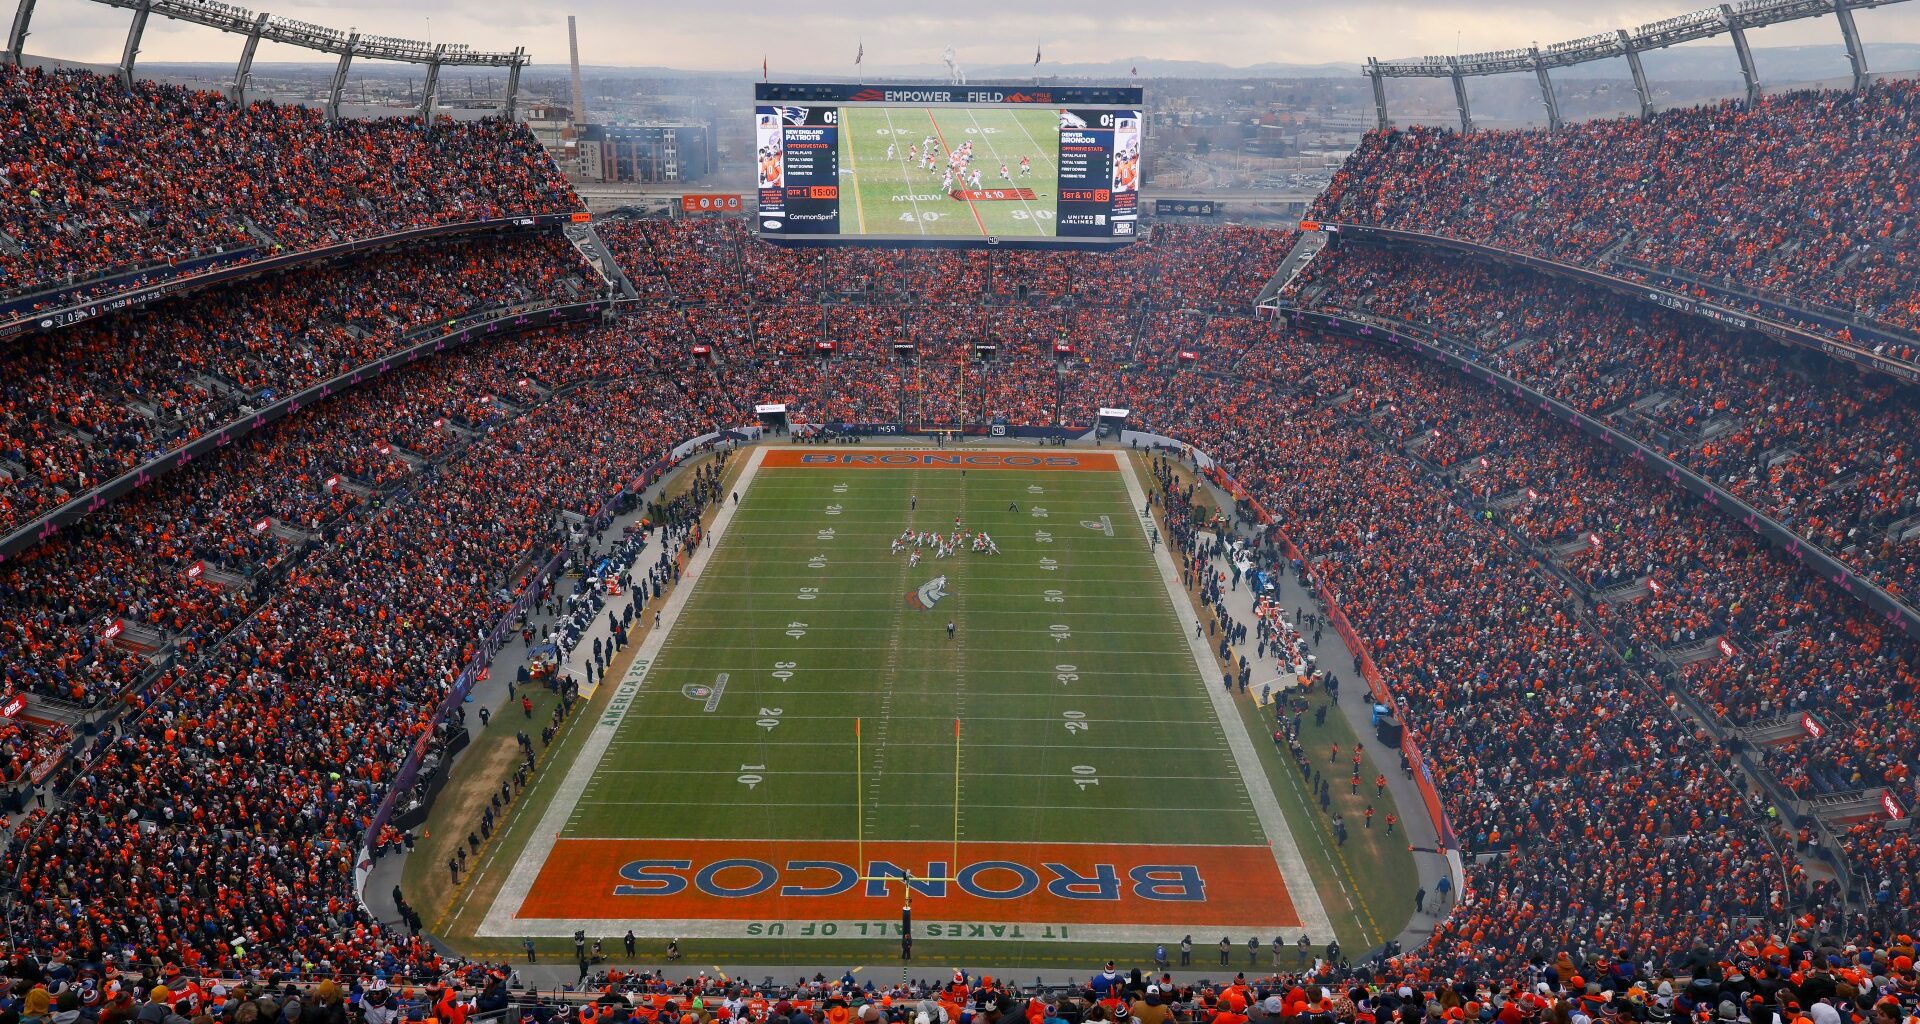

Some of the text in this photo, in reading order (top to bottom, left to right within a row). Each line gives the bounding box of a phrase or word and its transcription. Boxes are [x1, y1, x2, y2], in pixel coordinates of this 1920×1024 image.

[884, 92, 1003, 102] EMPOWER FIELD
[824, 112, 832, 123] 0
[1100, 114, 1109, 126] 0
[812, 188, 836, 197] 15:00
[112, 300, 126, 309] 14:59
[68, 313, 73, 322] 0
[91, 307, 96, 316] 0
[1835, 348, 1856, 359] THOMAS
[1886, 364, 1911, 378] MANNING
[802, 454, 1080, 466] BRONCOS
[797, 587, 818, 600] 50
[1044, 589, 1064, 603] 50
[786, 621, 808, 636] 40
[1050, 624, 1071, 639] 40
[772, 661, 796, 678] 30
[1056, 664, 1079, 681] 30
[601, 659, 650, 726] AMERICA 250
[756, 708, 783, 726] 20
[1063, 711, 1088, 730] 20
[737, 764, 766, 784] 10
[1072, 765, 1099, 786] 10
[613, 859, 1206, 902] BRONCOS
[747, 923, 784, 936] US
[801, 924, 837, 935] OF
[927, 924, 1024, 938] TAKES
[1042, 926, 1068, 938] IT
